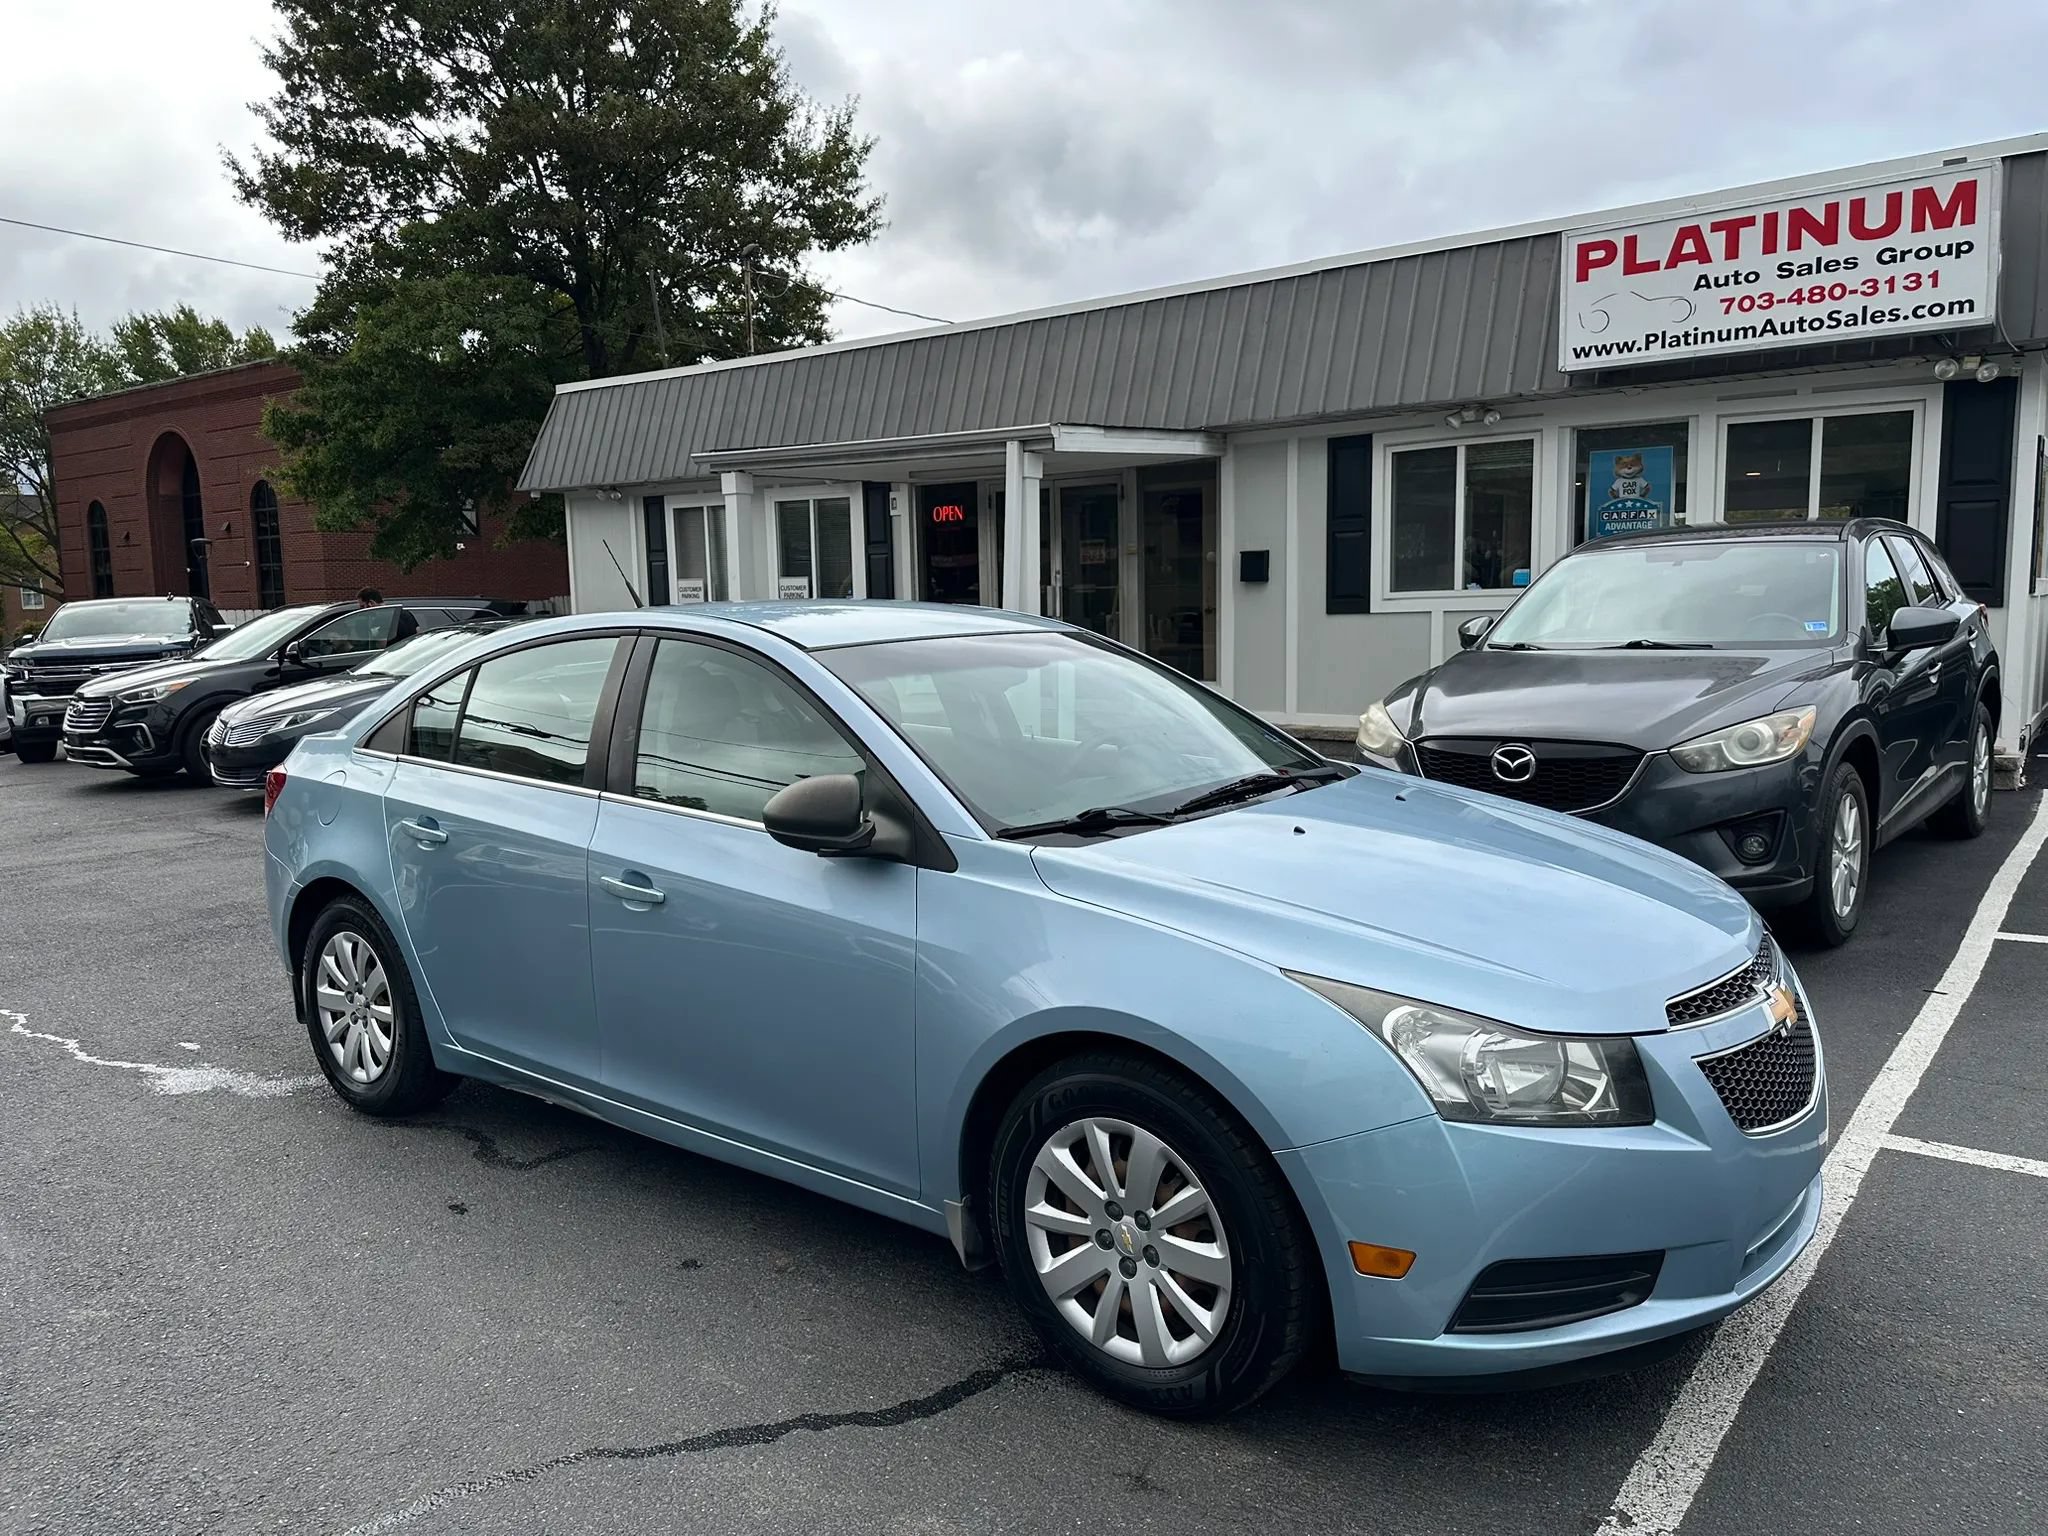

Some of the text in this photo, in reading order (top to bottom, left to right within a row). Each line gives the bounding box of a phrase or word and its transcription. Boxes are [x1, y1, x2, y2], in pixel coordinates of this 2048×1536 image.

[1576, 179, 1978, 283] PLATINUM
[1693, 238, 1975, 291] Auto Sales Group
[1720, 269, 1940, 315] 703-480-3131
[1572, 298, 1975, 359] www.PlatinumAutoSales.com
[933, 506, 963, 522] OPEN
[1602, 510, 1657, 520] CARFAX
[1605, 521, 1653, 531] ADVANTAGE
